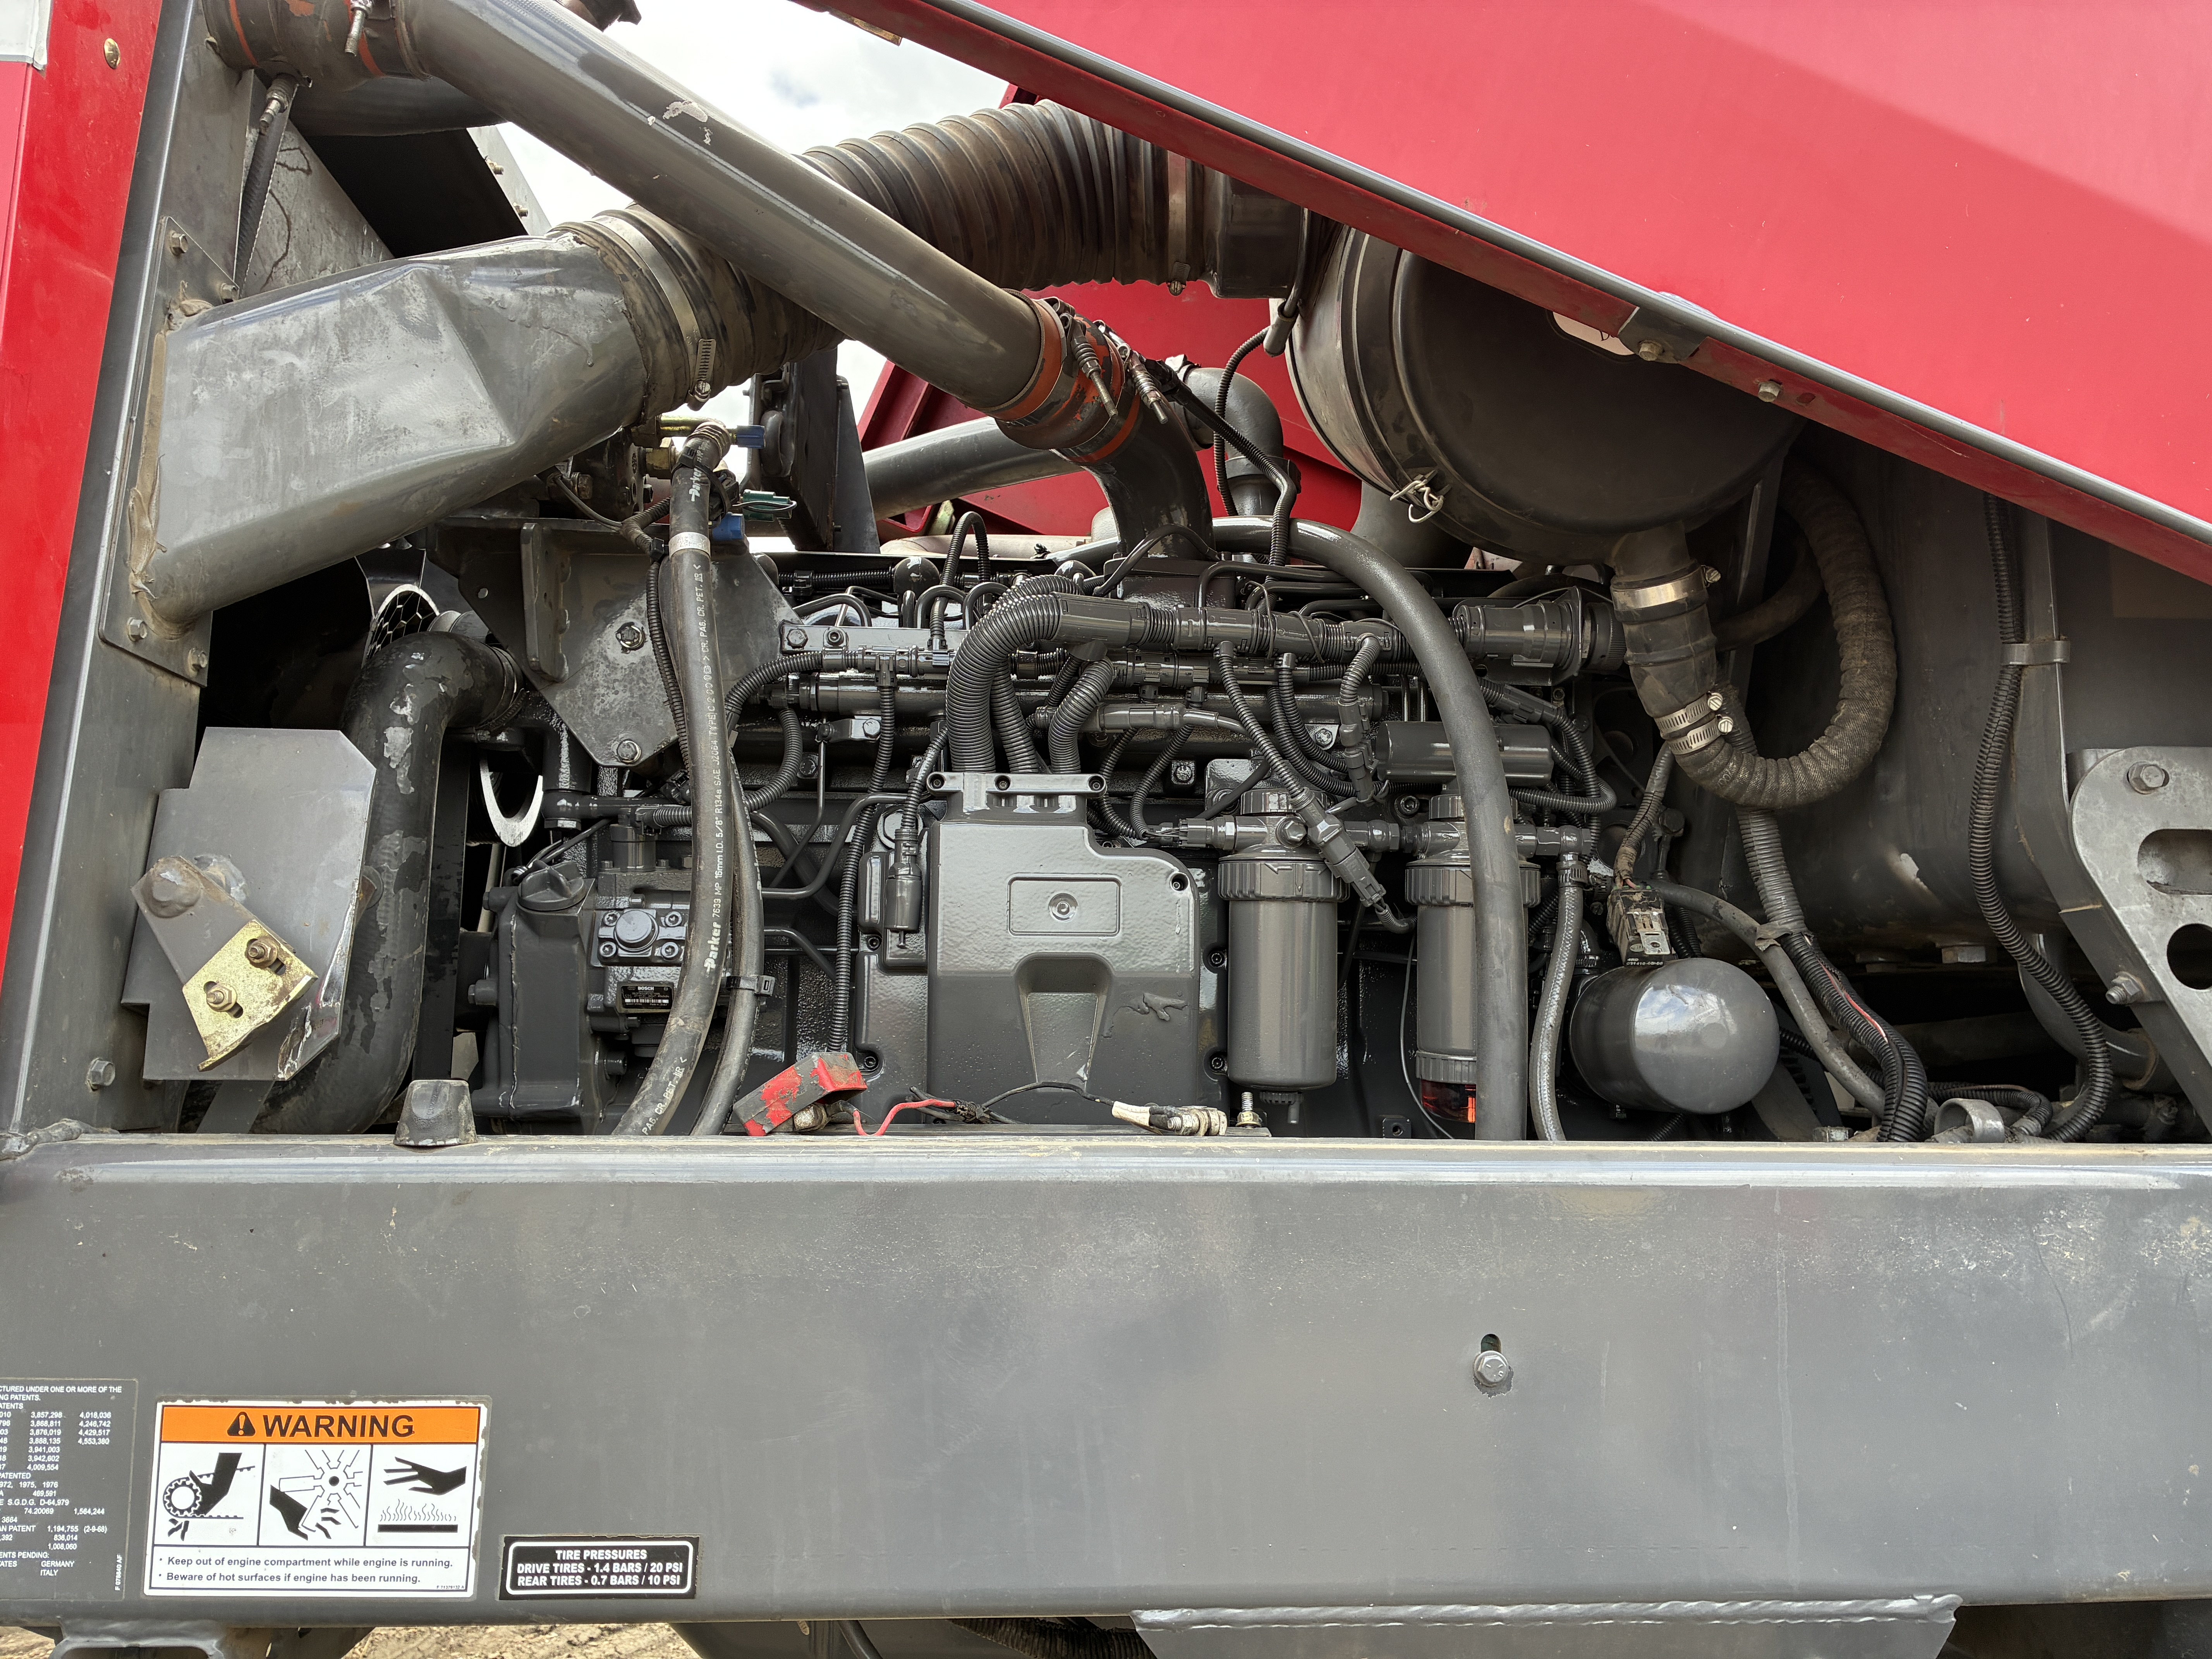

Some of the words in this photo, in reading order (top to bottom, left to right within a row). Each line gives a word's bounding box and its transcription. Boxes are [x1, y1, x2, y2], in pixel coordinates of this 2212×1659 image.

[710, 740, 720, 766] J2064
[713, 769, 721, 786] SAE
[714, 789, 723, 814] R134a
[715, 855, 723, 879] 16mm
[714, 882, 722, 895] MP
[712, 898, 721, 918] 7639
[704, 922, 722, 972] Parker
[263, 1415, 415, 1437] WARNING
[117, 1554, 122, 1563] AF
[555, 1550, 581, 1560] TIRE
[583, 1549, 647, 1560] PRESSURES
[168, 1557, 193, 1567] Keep
[215, 1557, 225, 1565] of
[227, 1557, 261, 1568] engine
[264, 1558, 331, 1568] compartment
[334, 1558, 360, 1566] while
[363, 1558, 397, 1568] engine
[400, 1558, 408, 1566] is
[411, 1558, 453, 1569] running.
[517, 1563, 550, 1573] DRIVE
[553, 1563, 585, 1573] TIRES
[594, 1563, 610, 1573] 1.4
[613, 1562, 642, 1573] BARS
[644, 1563, 648, 1573] /
[650, 1562, 663, 1573] 20
[665, 1562, 683, 1573] PSI
[167, 1572, 203, 1581] Beware
[206, 1573, 216, 1581] of
[219, 1573, 235, 1581] hot
[238, 1573, 281, 1582] surfaces
[284, 1573, 291, 1582] if
[293, 1573, 327, 1583] engine
[330, 1573, 348, 1582] has
[352, 1573, 376, 1582] been
[379, 1574, 420, 1584] running.
[518, 1576, 547, 1586] REAR
[550, 1575, 582, 1586] TIRES
[591, 1575, 608, 1585] 0.7
[610, 1575, 639, 1585] BARS
[641, 1575, 646, 1585] /
[647, 1575, 661, 1585] 10
[663, 1575, 680, 1585] PSI
